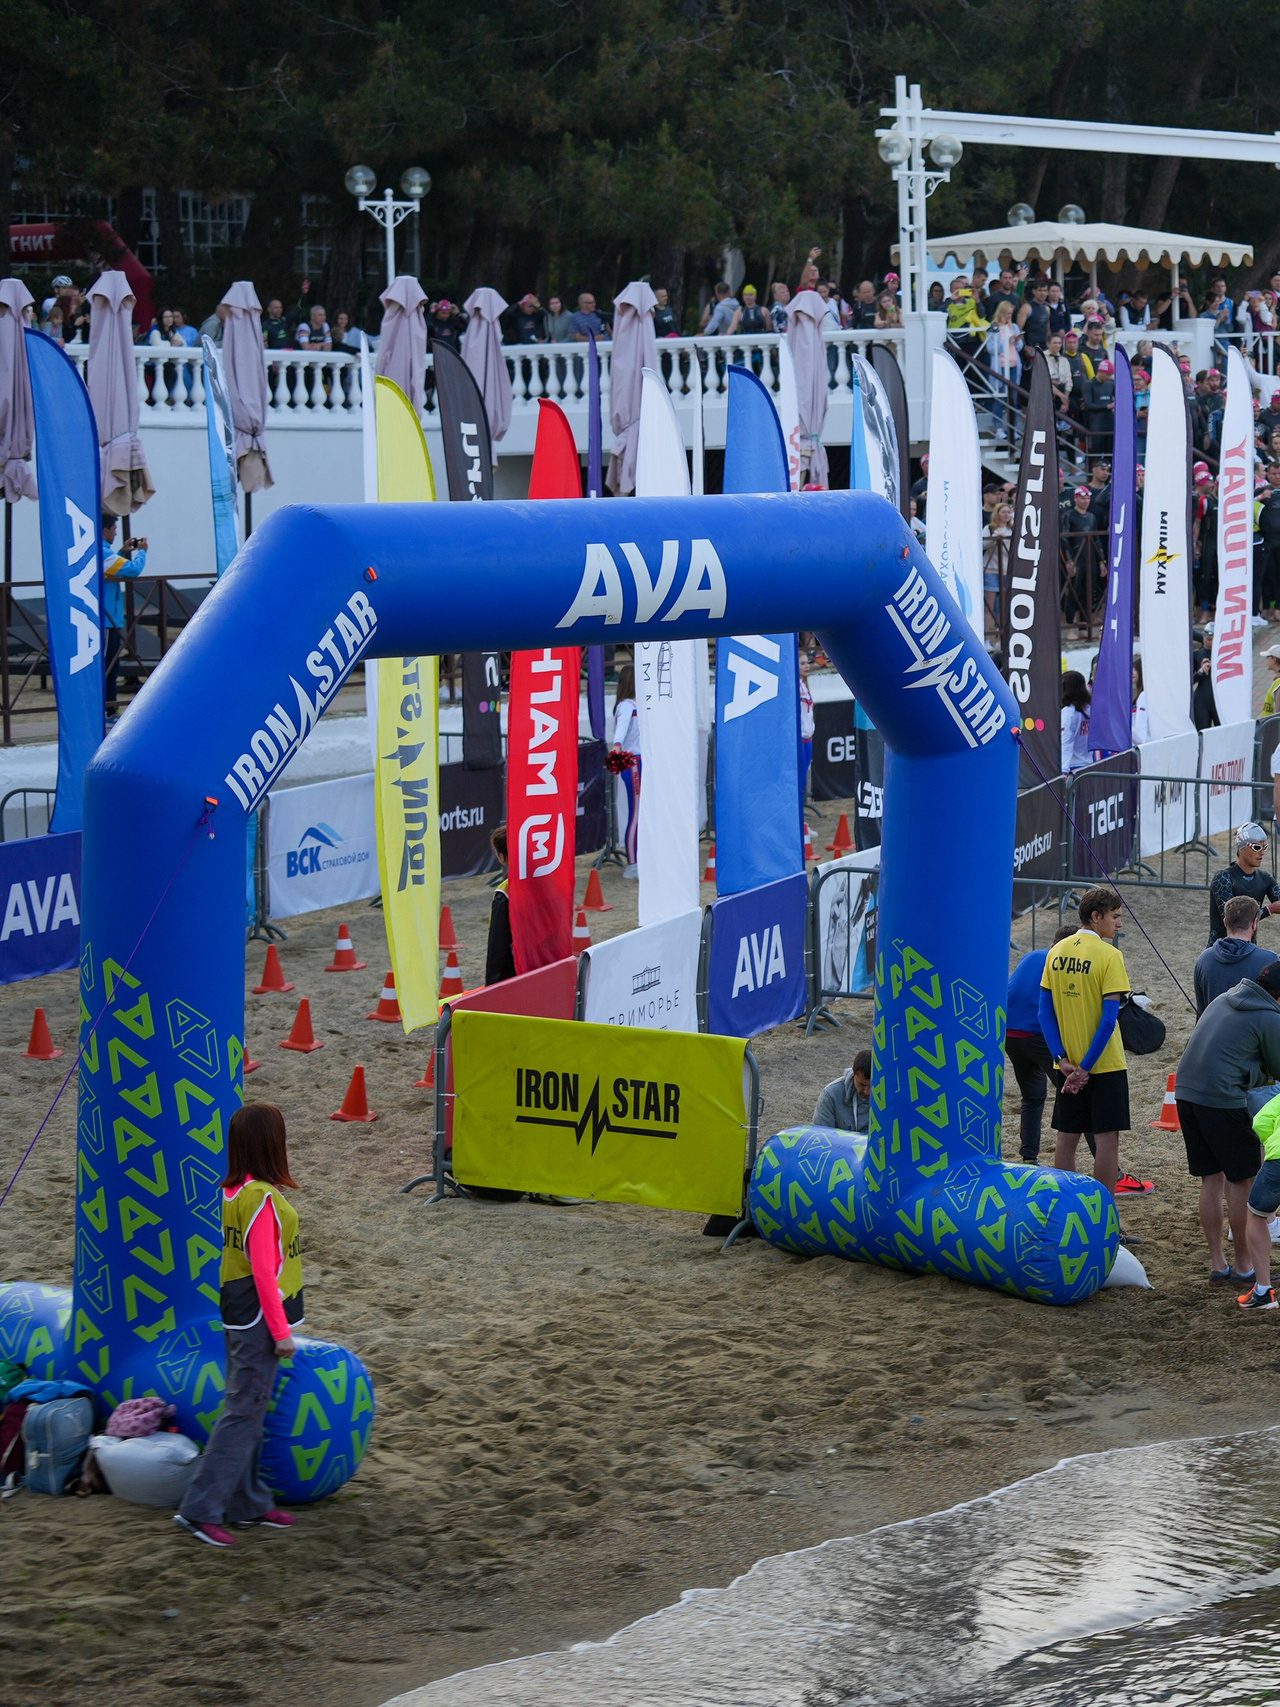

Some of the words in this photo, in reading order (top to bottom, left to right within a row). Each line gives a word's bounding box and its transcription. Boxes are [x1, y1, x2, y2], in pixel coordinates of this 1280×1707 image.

[10, 234, 55, 252] ГНИТ
[554, 538, 728, 629] AVA
[892, 565, 952, 659] IRON
[949, 657, 1007, 746] STAR
[224, 702, 299, 813] IRON
[306, 590, 379, 694] STAR
[286, 845, 322, 878] ВСК
[322, 853, 357, 870] СТРАХОВОЙ
[356, 851, 370, 864] ДОМ
[1013, 830, 1052, 873] sports.ru
[0, 873, 81, 940] AVA
[731, 923, 786, 1000] AVA
[1052, 956, 1092, 975] СУДЬЯ
[608, 989, 680, 1027] ПРИМОРЬЕ
[516, 1068, 580, 1113] IRON
[612, 1077, 681, 1124] STAR
